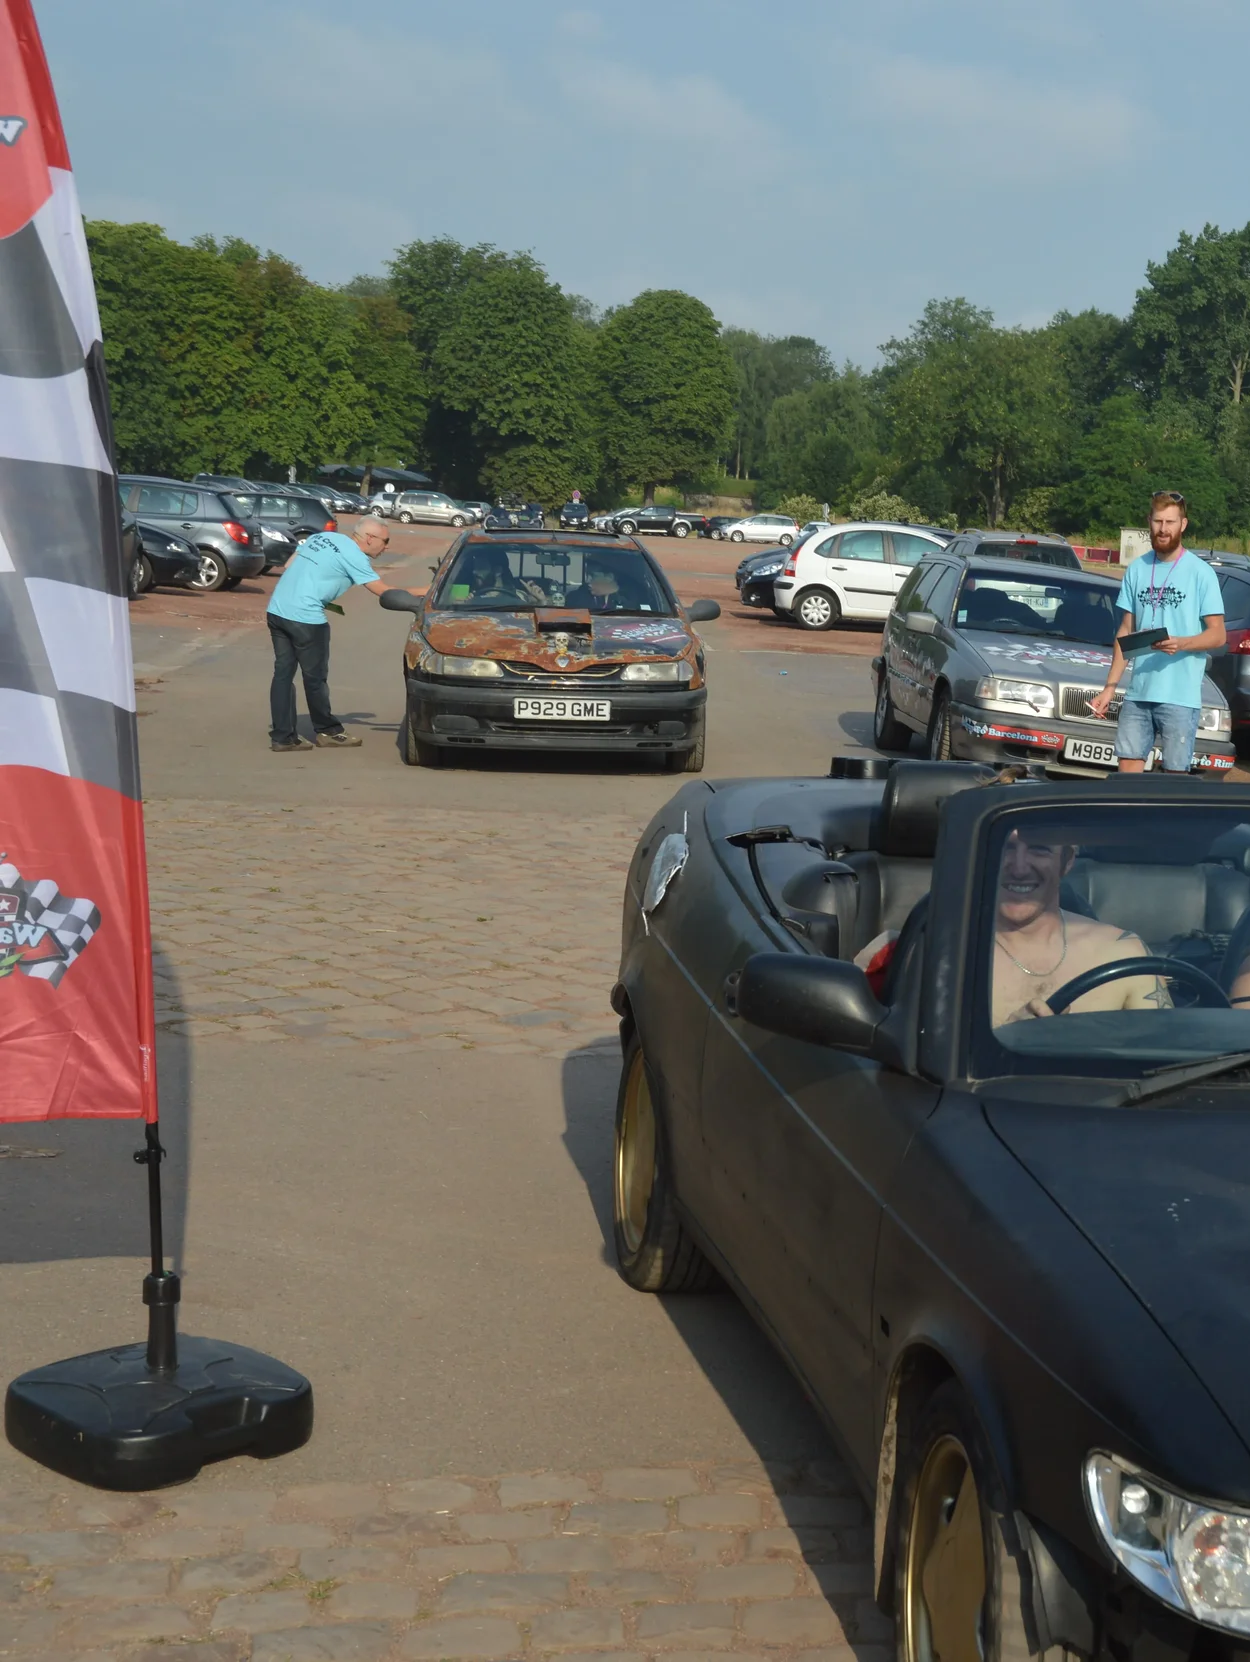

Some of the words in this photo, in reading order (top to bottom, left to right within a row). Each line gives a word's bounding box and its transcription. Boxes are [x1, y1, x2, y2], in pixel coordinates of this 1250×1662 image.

[517, 701, 567, 716] P929
[571, 703, 607, 717] GME
[988, 727, 1039, 743] Barcelona
[1071, 742, 1114, 762] M989
